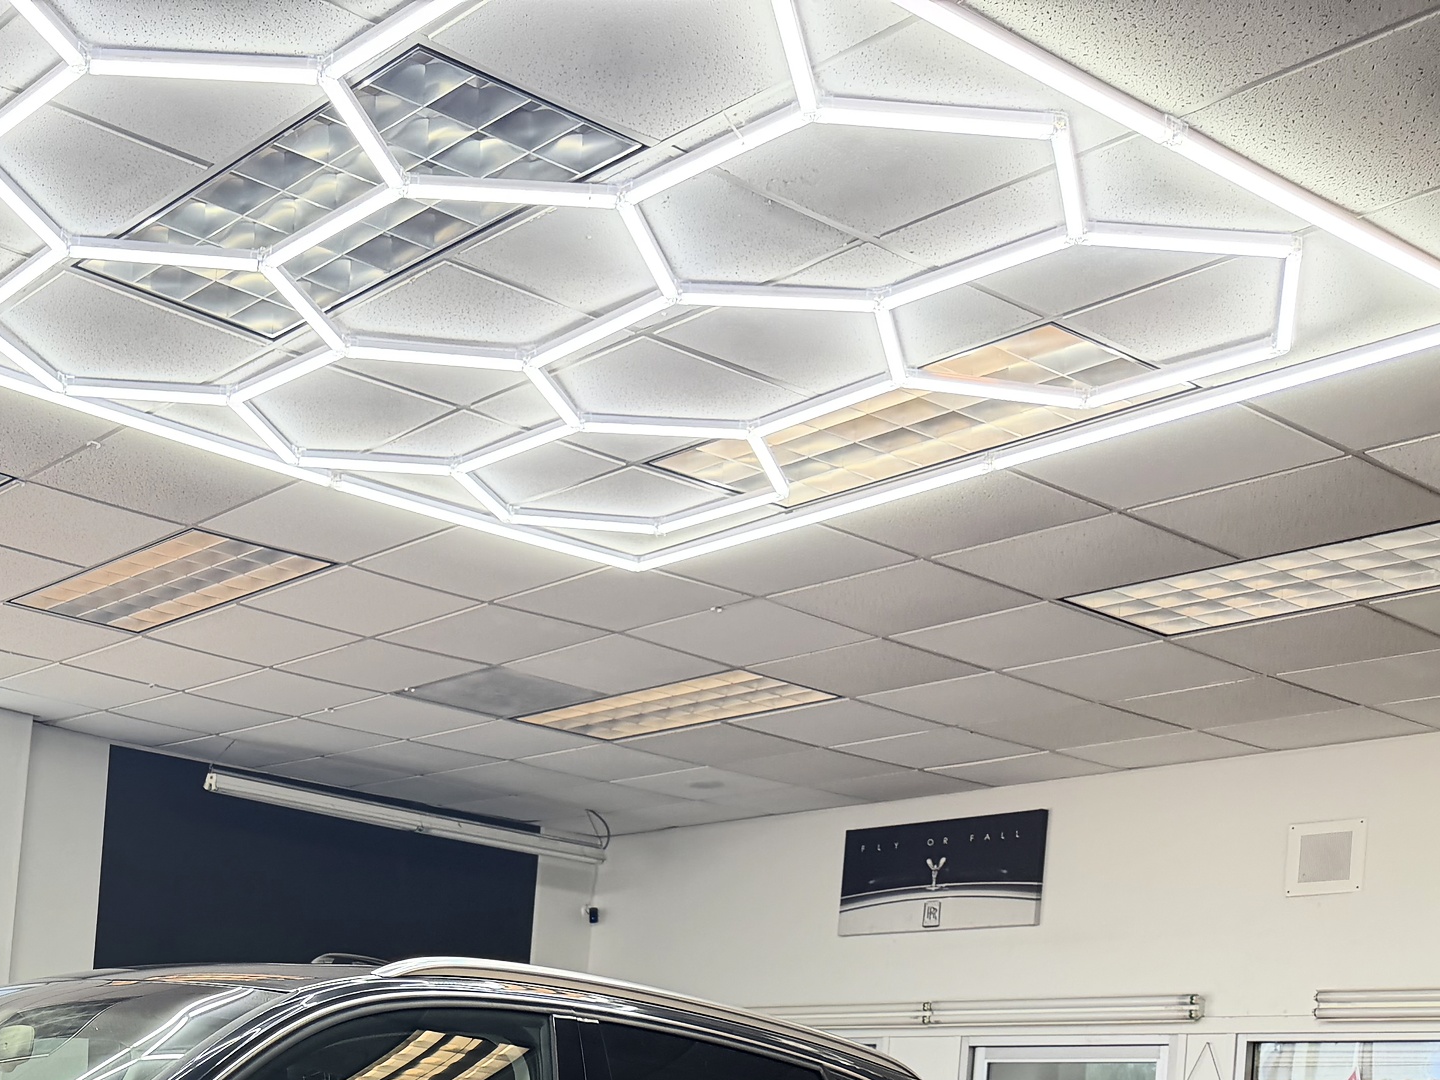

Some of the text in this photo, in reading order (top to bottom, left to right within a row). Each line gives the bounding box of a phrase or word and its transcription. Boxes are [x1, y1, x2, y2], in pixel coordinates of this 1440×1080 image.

[861, 830, 1020, 853] FLY OR FALL
